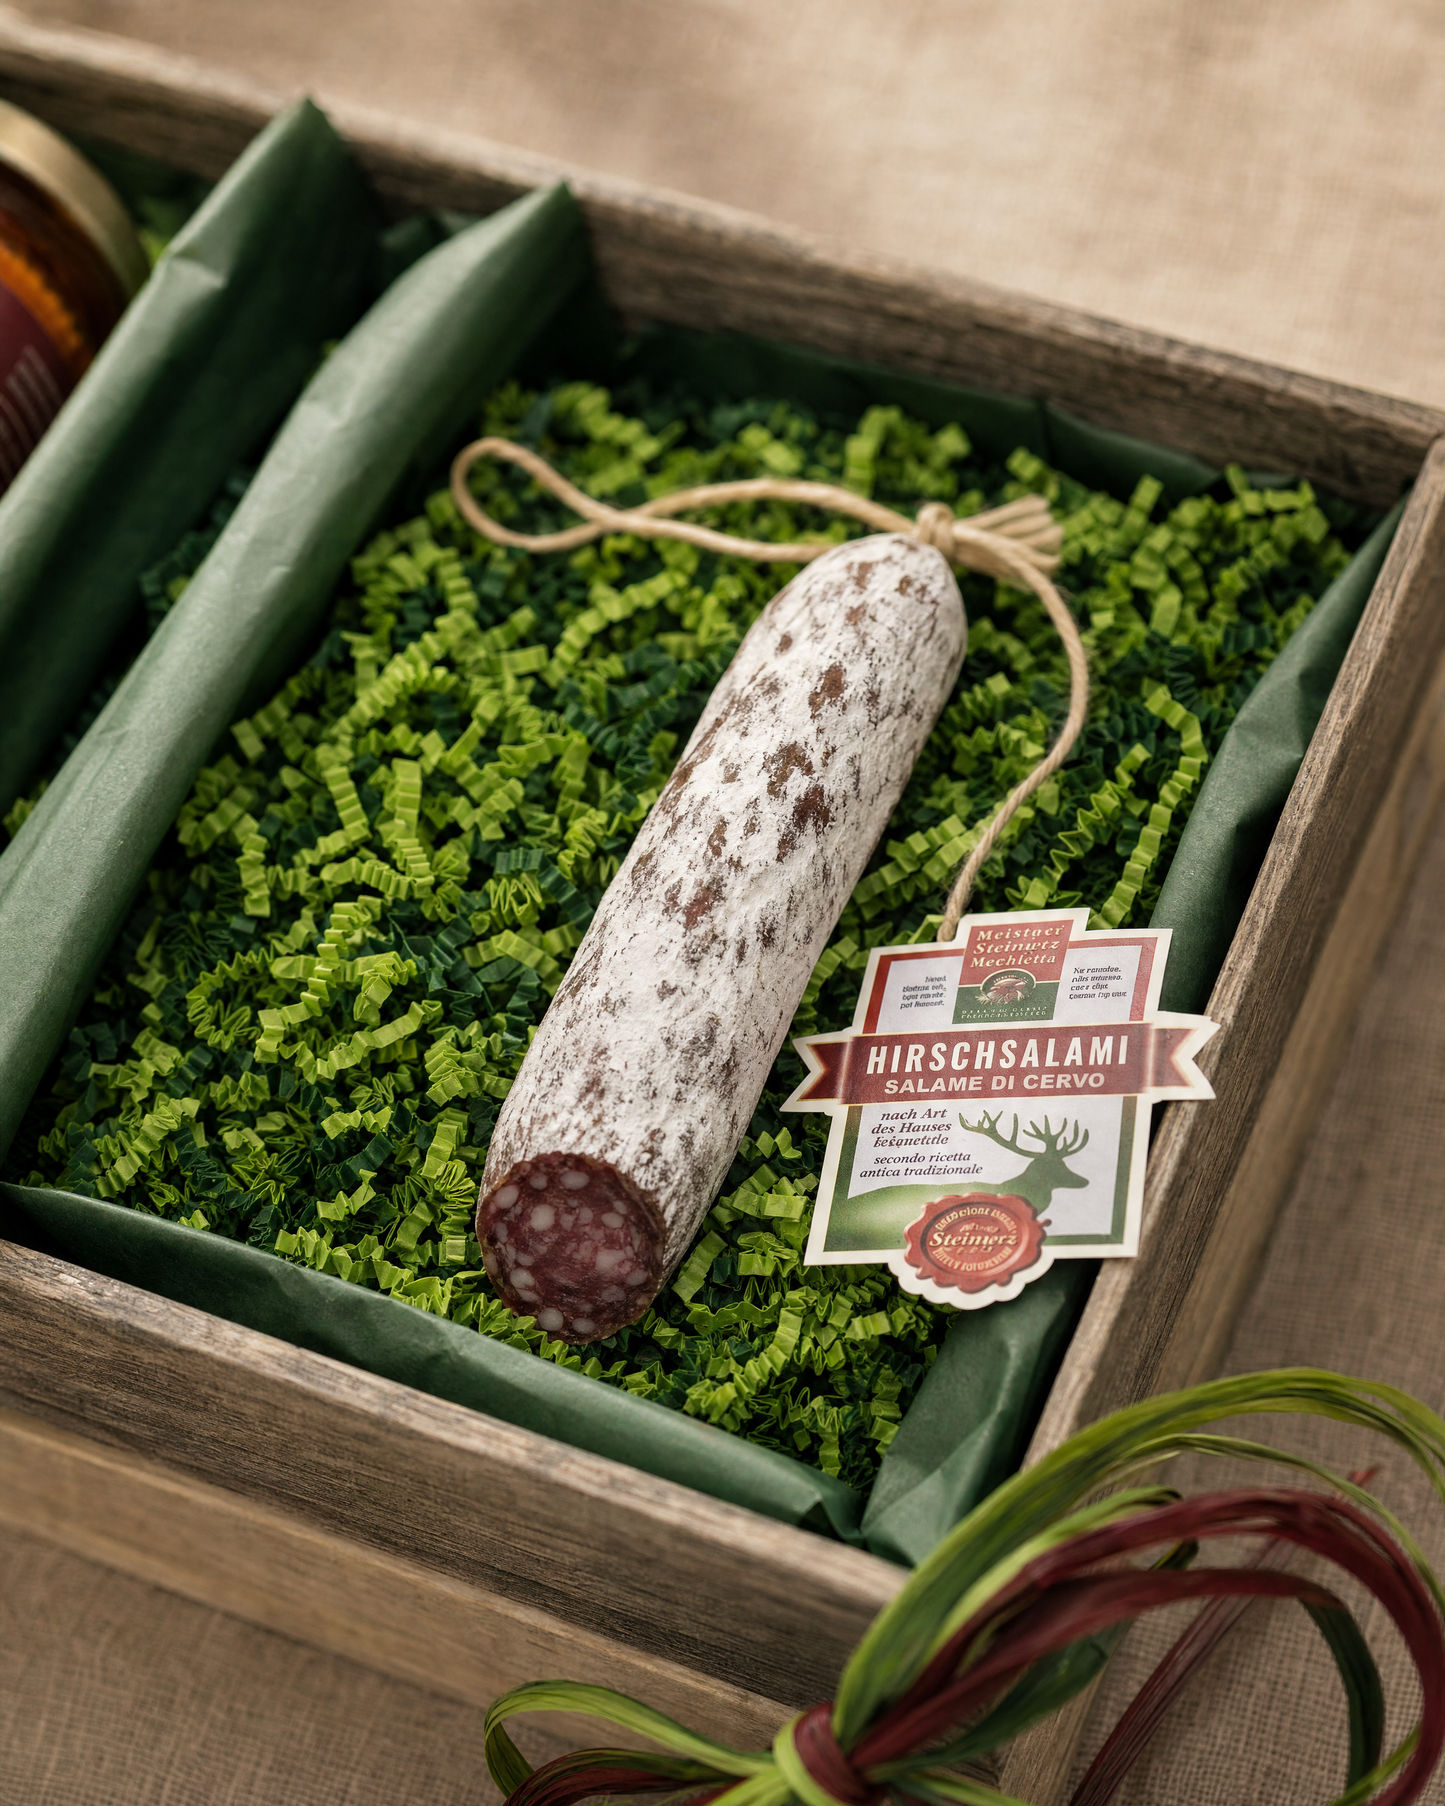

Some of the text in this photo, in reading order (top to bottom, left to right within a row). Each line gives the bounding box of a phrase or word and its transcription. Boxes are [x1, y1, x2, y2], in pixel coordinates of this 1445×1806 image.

[866, 1035, 1129, 1074] HIRSCHSALAMI
[884, 1072, 1105, 1094] SALAME DI CERVO
[881, 1107, 948, 1121] nach Art
[871, 1122, 952, 1135] des Hauses
[874, 1152, 971, 1164] secondo ricetta
[860, 1164, 983, 1178] antica tradizionale
